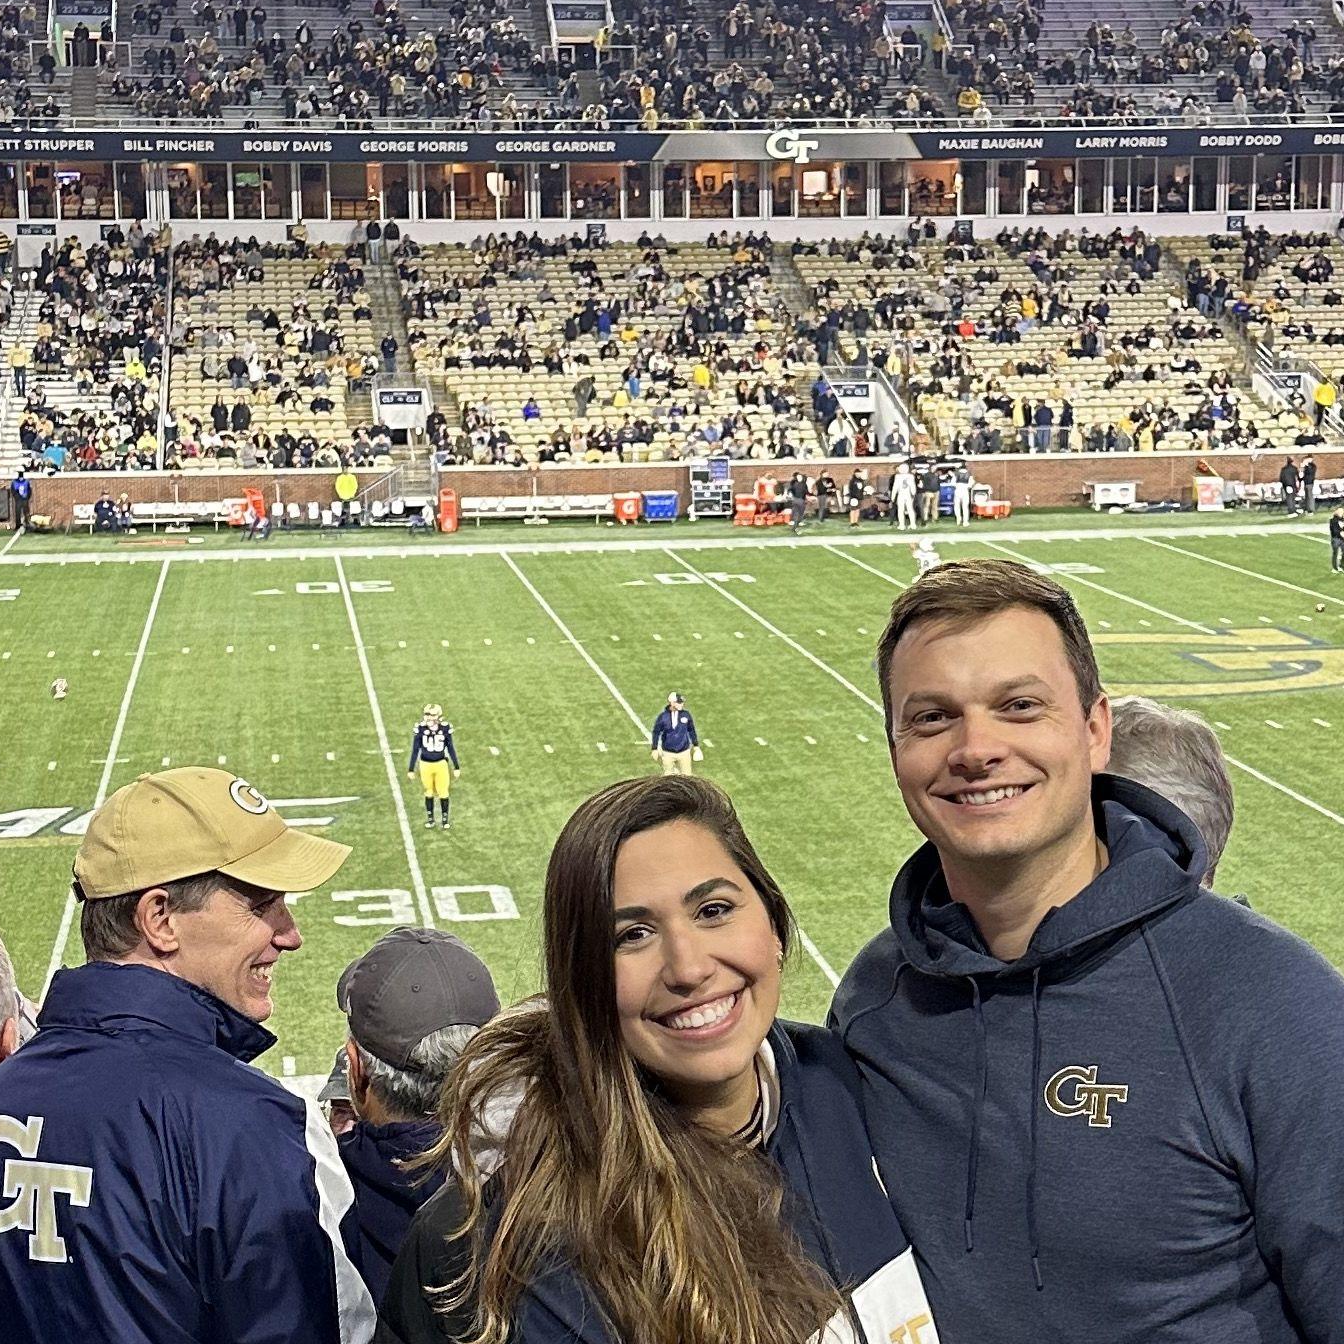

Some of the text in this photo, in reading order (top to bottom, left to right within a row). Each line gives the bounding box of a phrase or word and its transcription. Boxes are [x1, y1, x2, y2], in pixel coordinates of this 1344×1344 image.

[23, 138, 95, 151] STRUPPER
[123, 139, 215, 152] BILL FINCHER
[243, 140, 333, 152] BOBBY DAVIS
[359, 140, 469, 153] GEORGE MORRIS
[495, 140, 616, 153] GEORGE GARDNER
[766, 129, 819, 163] GT
[938, 137, 1044, 150] MAXIE BAUGHAN
[1075, 136, 1168, 149] LARRY MORRIS
[1199, 134, 1283, 147] BOBBY DODD
[329, 884, 520, 925] 30
[1043, 1064, 1129, 1128] GT
